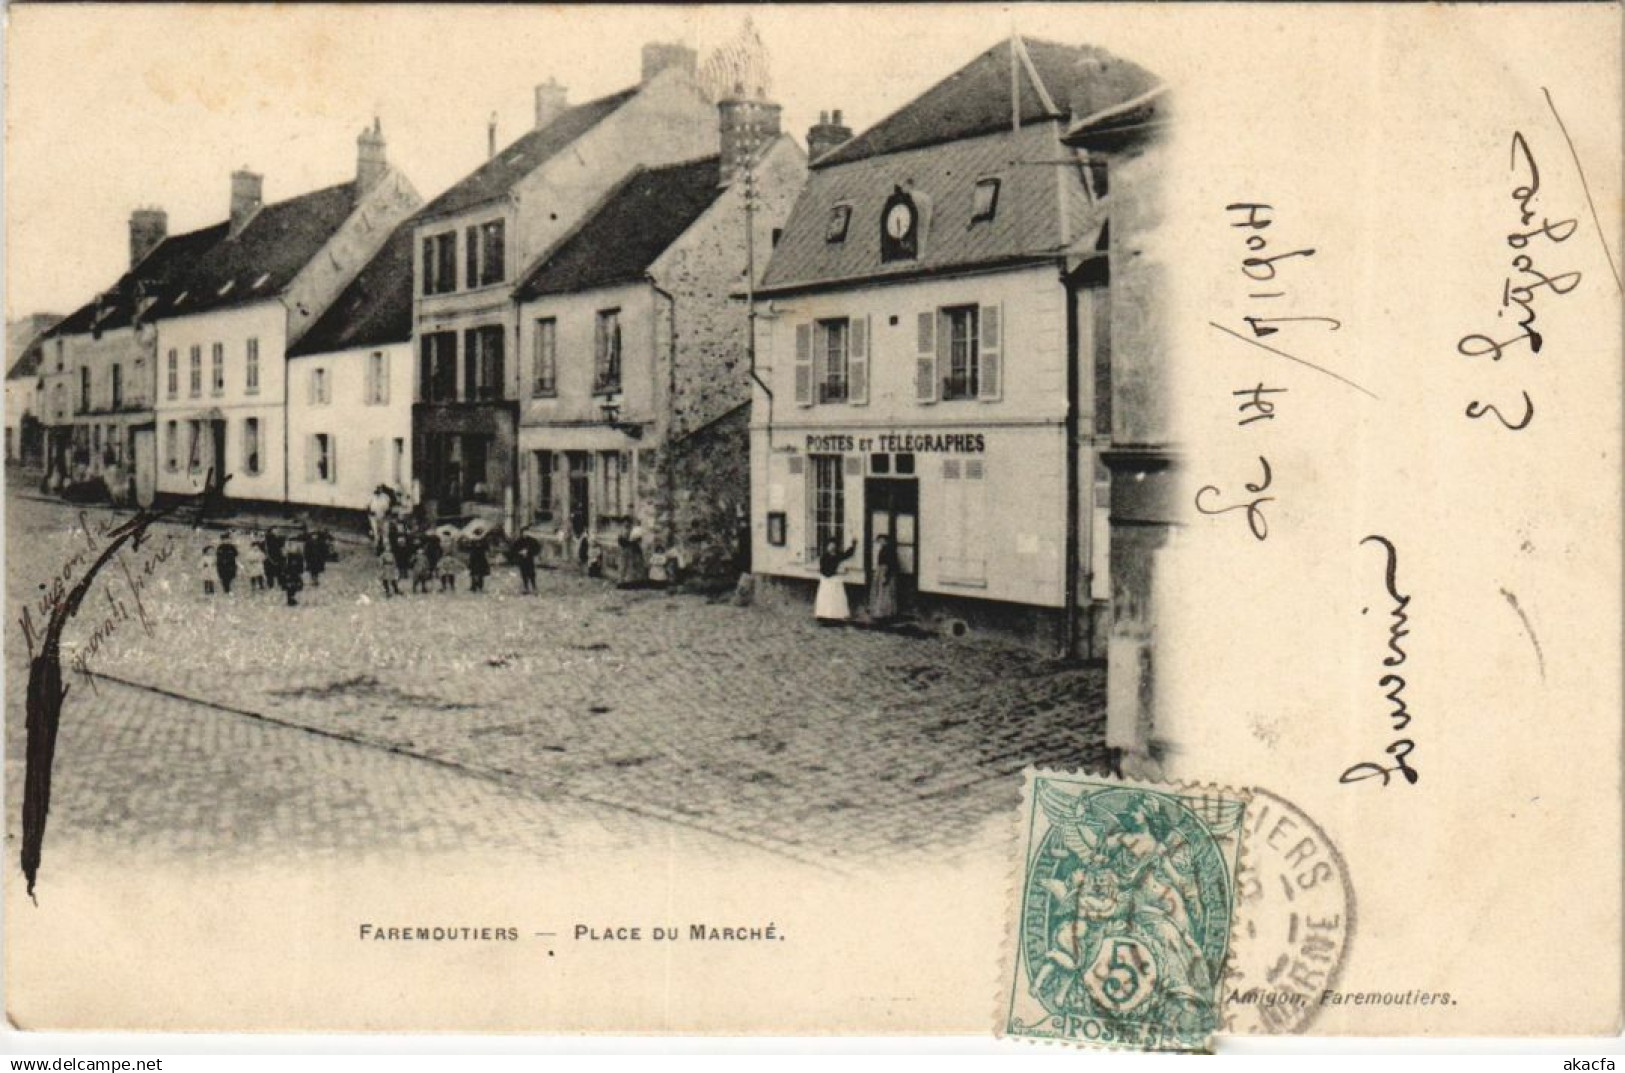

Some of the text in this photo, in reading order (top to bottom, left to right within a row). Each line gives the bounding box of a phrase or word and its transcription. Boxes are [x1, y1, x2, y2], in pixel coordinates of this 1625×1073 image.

[806, 434, 854, 451] POSTES
[878, 430, 985, 452] TÉLÉGRAPHES
[1195, 455, 1275, 541] Le
[1339, 534, 1419, 787] Souvenir
[1104, 938, 1138, 1003] 5
